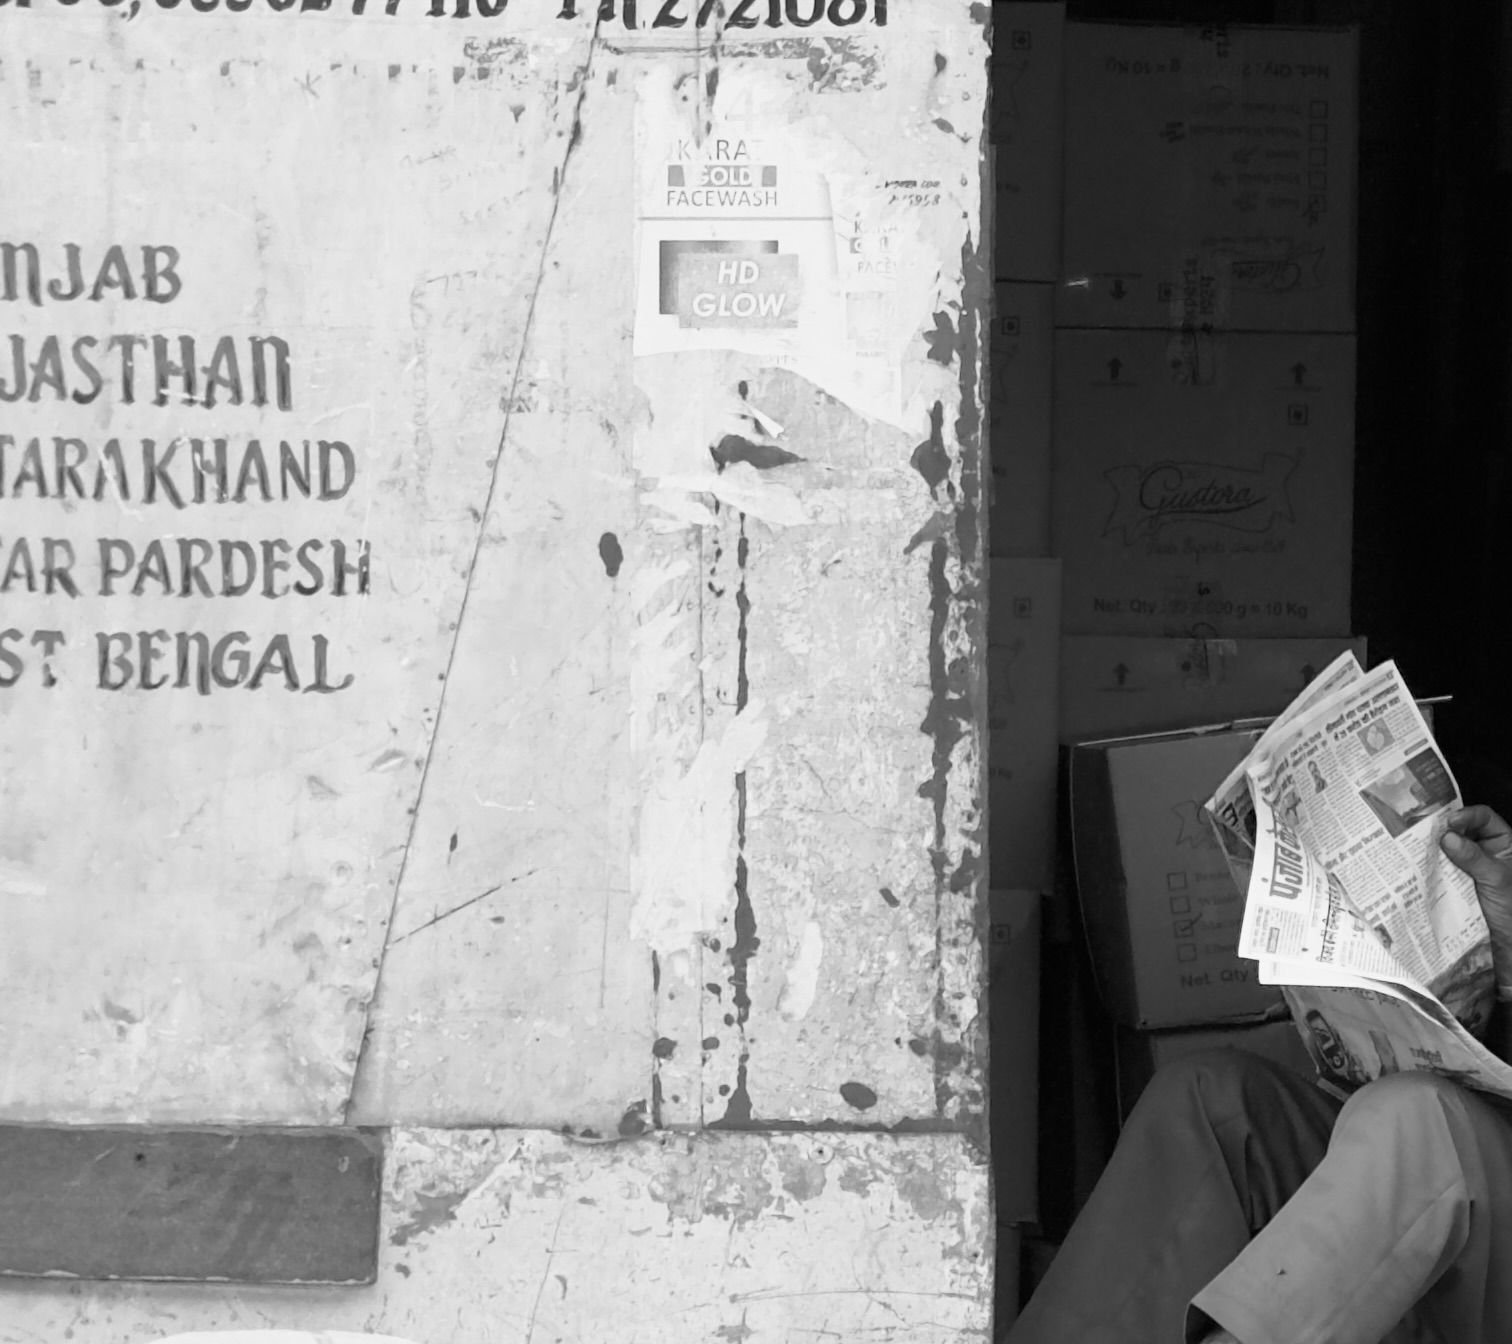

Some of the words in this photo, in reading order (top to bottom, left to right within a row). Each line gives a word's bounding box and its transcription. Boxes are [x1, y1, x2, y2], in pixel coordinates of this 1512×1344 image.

[666, 190, 778, 207] FACEWASH
[718, 260, 760, 285] HD
[692, 292, 786, 318] GLOW
[97, 537, 371, 599] PARDESH
[95, 629, 355, 695] BENGAL
